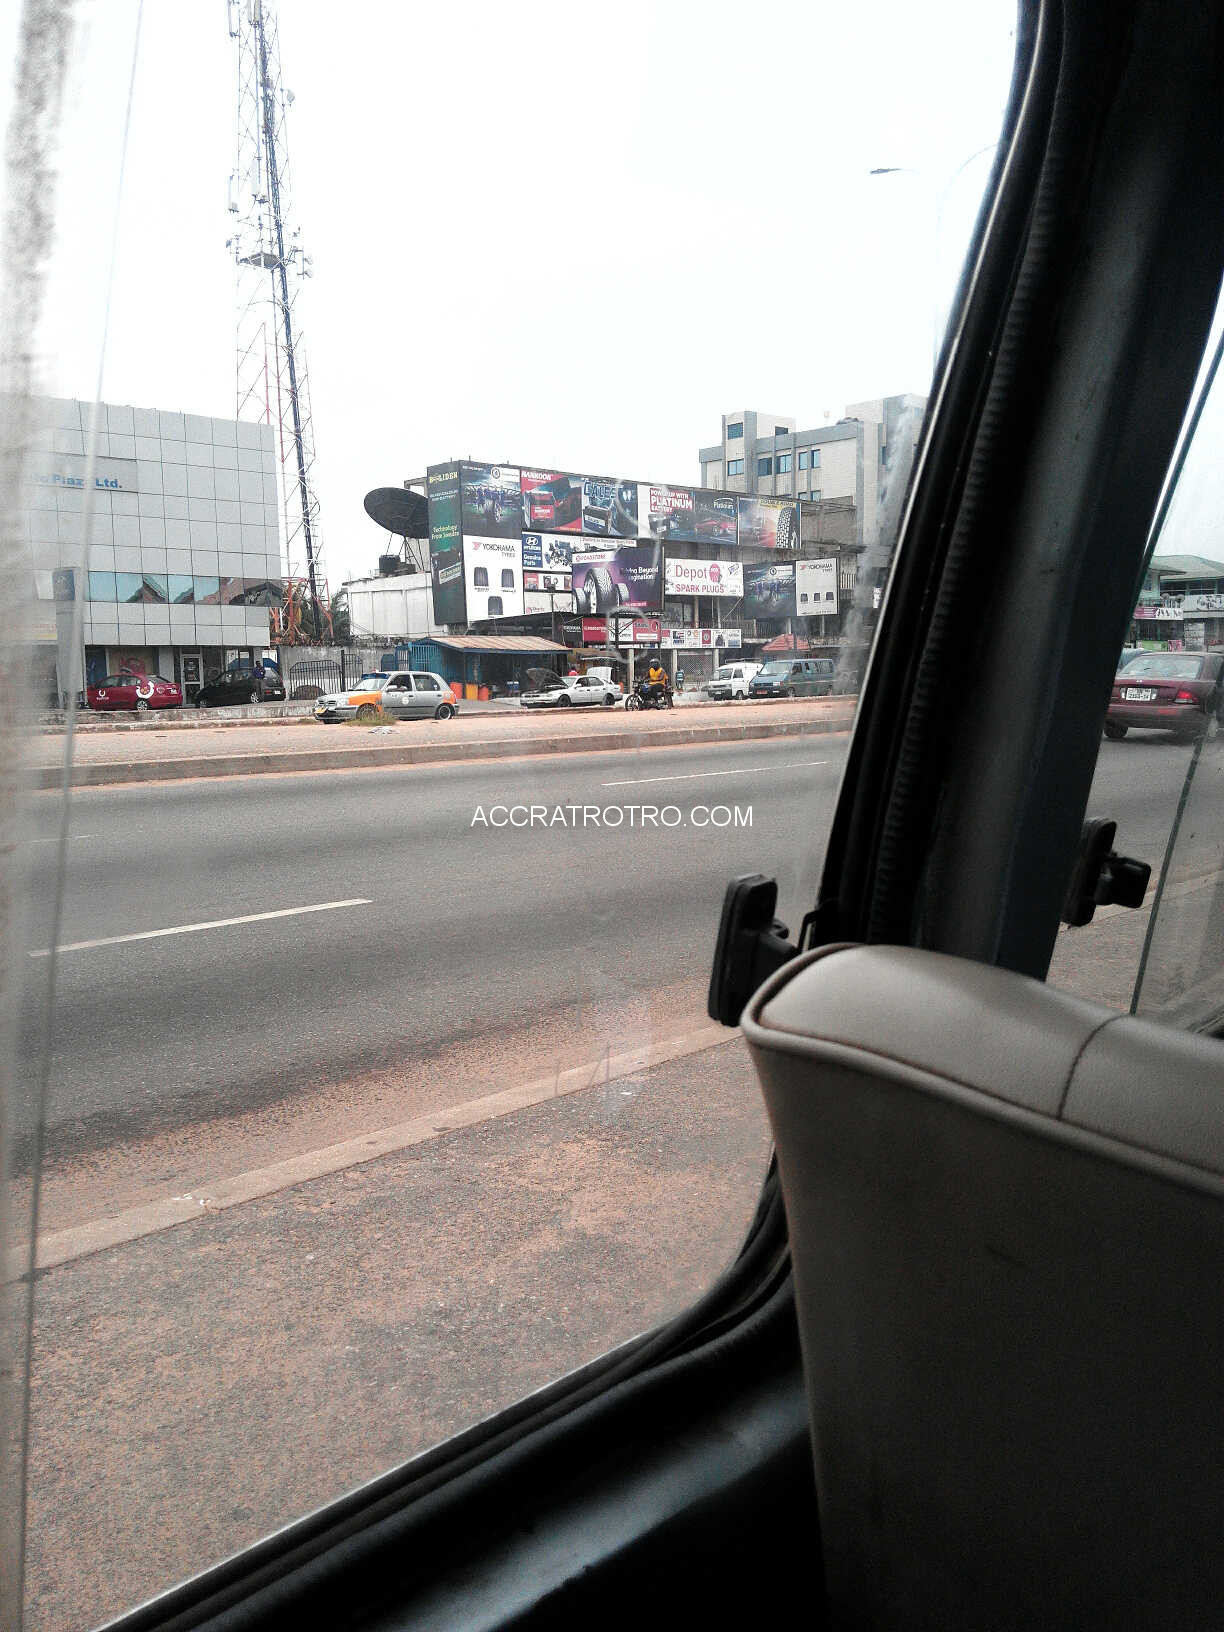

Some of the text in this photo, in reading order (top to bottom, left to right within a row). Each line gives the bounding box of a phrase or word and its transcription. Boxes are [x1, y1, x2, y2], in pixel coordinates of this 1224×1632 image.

[95, 477, 123, 489] Ltd.
[676, 492, 688, 500] WITH
[651, 496, 692, 511] PLATINUM
[483, 543, 515, 552] YOKOHAMA
[638, 566, 659, 574] Beyond
[675, 565, 707, 581] Depot
[675, 584, 725, 593] SPARK PLUGS
